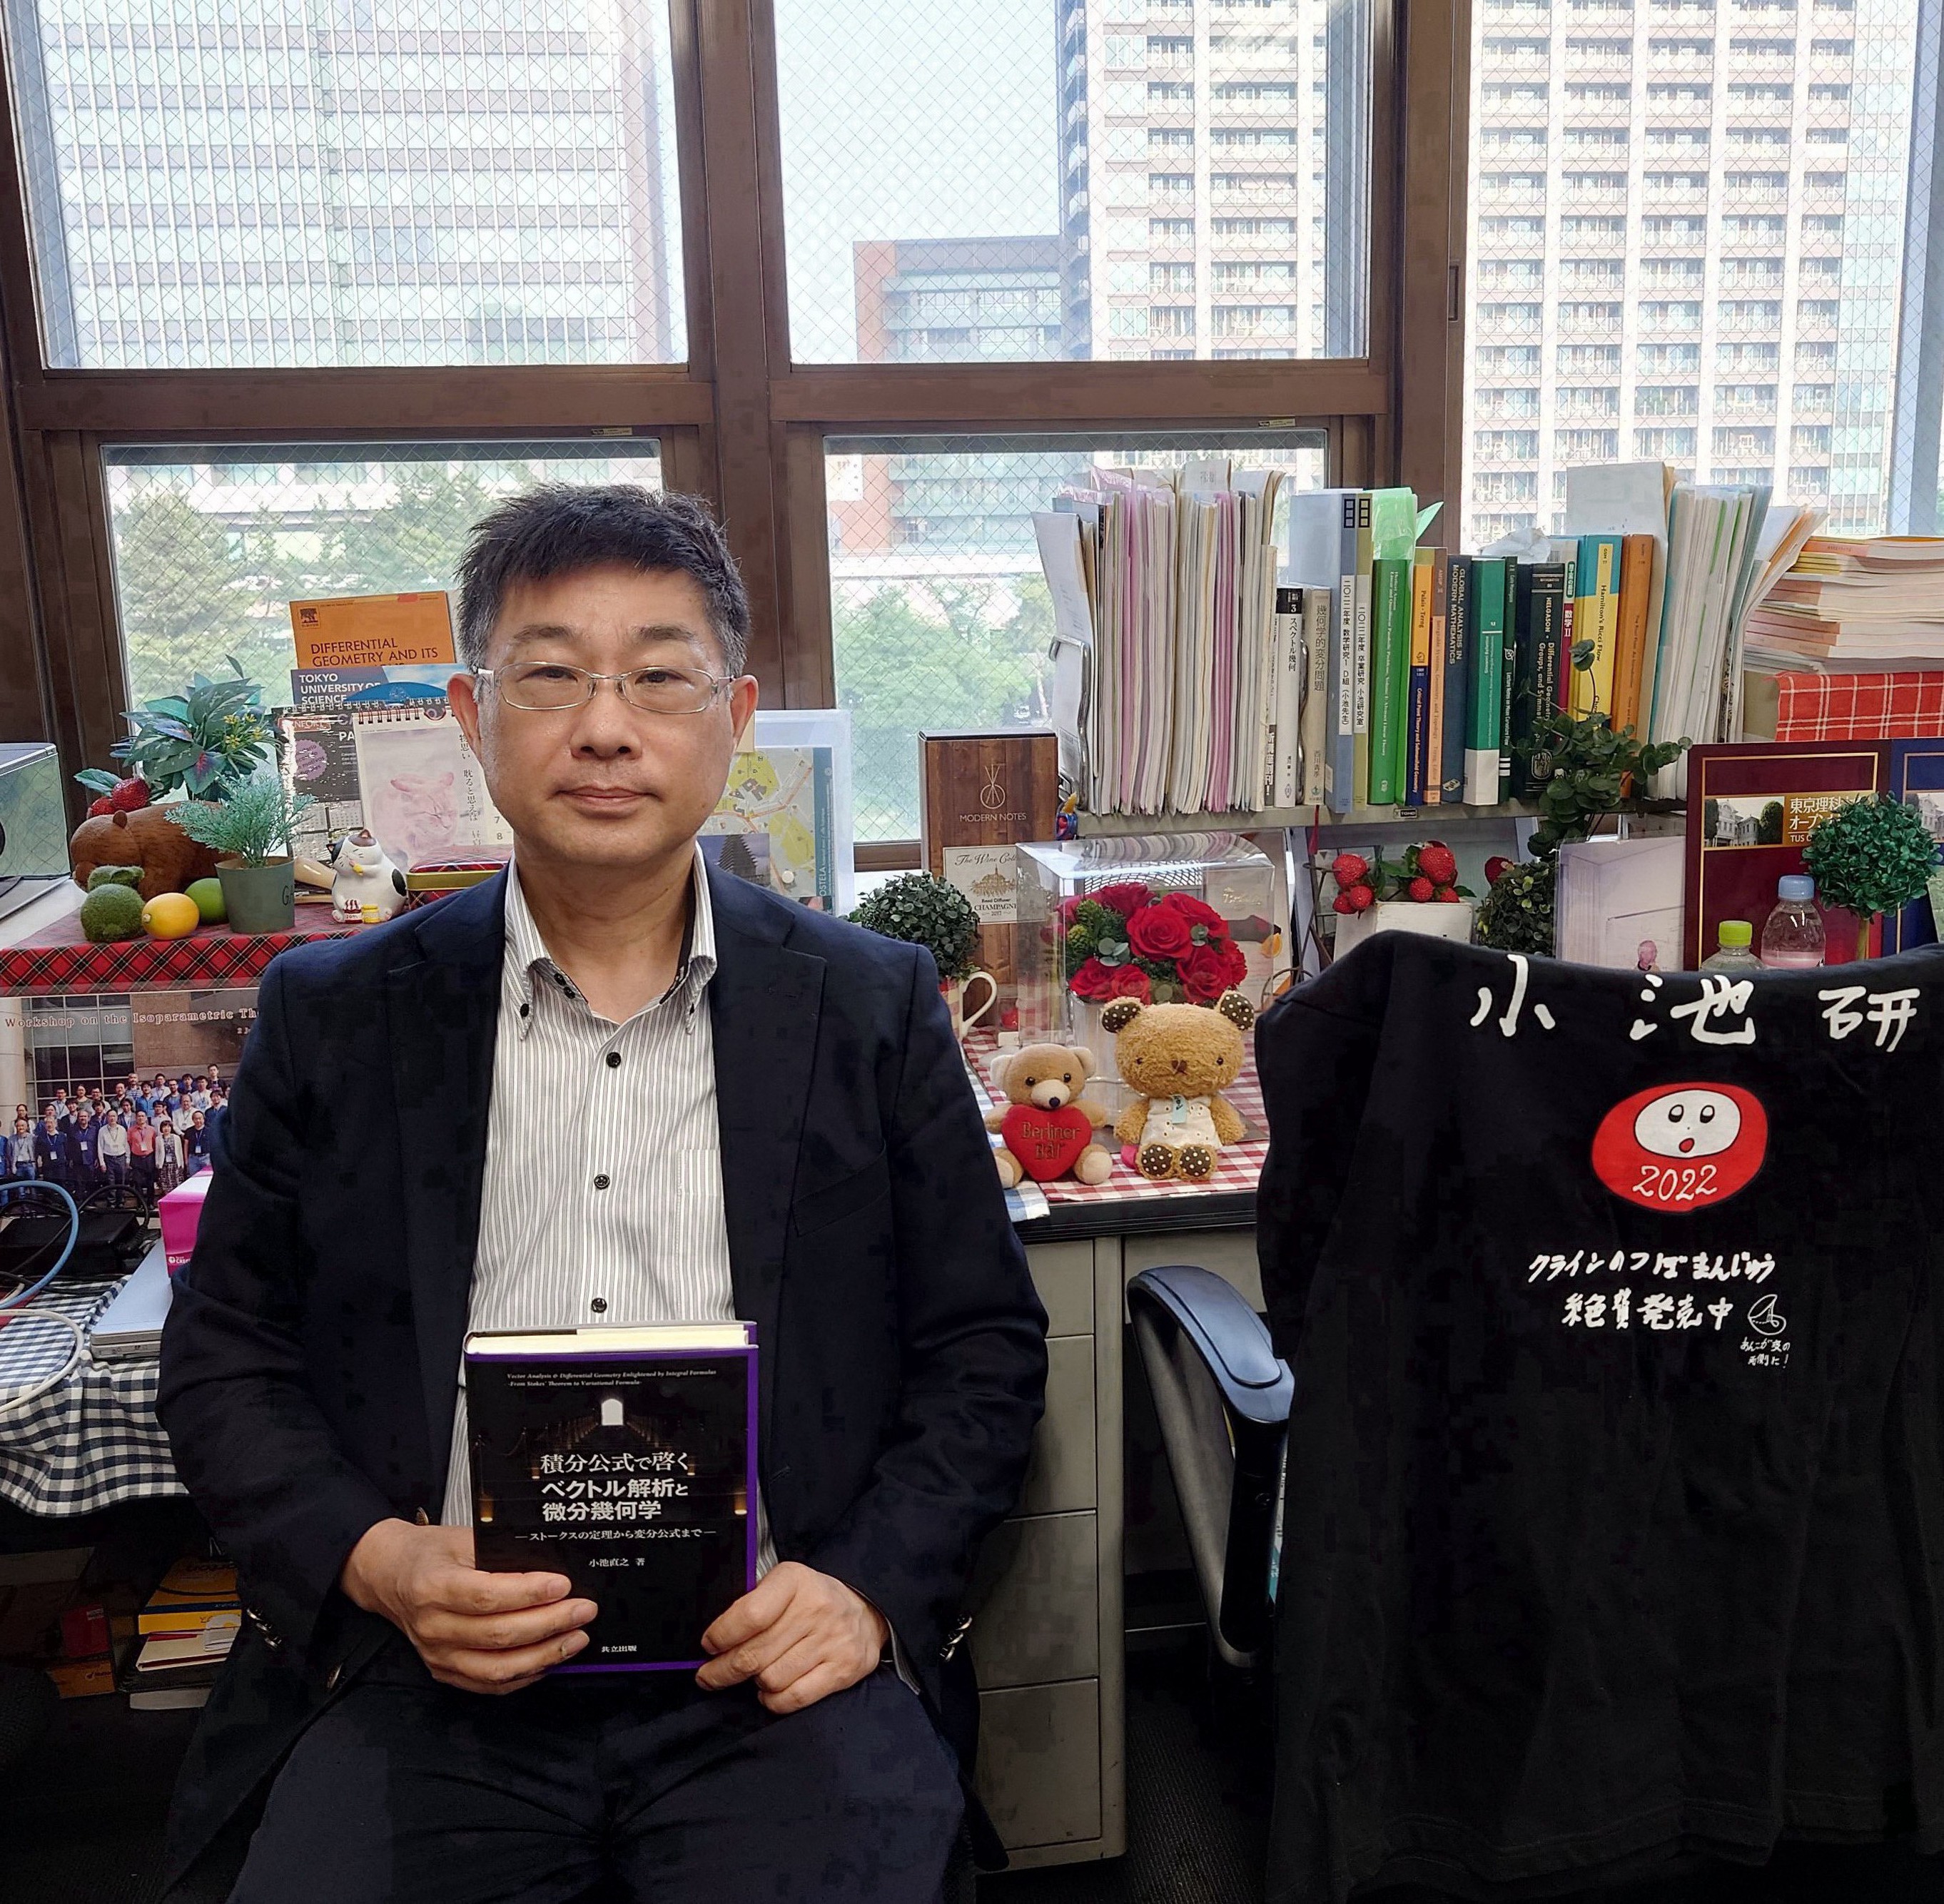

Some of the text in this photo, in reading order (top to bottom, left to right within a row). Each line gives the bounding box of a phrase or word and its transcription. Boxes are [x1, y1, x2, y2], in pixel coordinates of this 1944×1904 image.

[1290, 604, 1297, 613] 3
[311, 638, 398, 654] DIFFERENTIAL
[1287, 617, 1297, 672] スペクトル幾何
[1314, 604, 1327, 692] 幾何学的変分問題
[1456, 650, 1462, 659] IN
[312, 647, 439, 668] GEOMETRY AND ITS
[1537, 642, 1546, 672] Groups,
[1546, 642, 1555, 684] Differential
[299, 673, 338, 683] TOKYO
[1357, 655, 1365, 685] 卒業研究
[300, 683, 365, 694] UNIVERSITY
[1356, 688, 1365, 726] 小池研究室
[494, 816, 500, 824] 7
[959, 812, 1027, 822] MODERN NOTES
[496, 832, 503, 841] 8
[1790, 834, 1806, 843] TUS
[955, 853, 973, 866] The
[973, 852, 998, 865] Wine
[5, 1016, 75, 1029] Workshop
[81, 1016, 98, 1026] on
[105, 1013, 127, 1024] the
[133, 1008, 234, 1026] Isoparametric
[1022, 1121, 1081, 1140] Berliner
[1632, 1165, 1718, 1202] 2022
[1561, 1287, 1734, 1331] 絶賛発売中
[540, 1451, 689, 1474] 積分公式で啓く
[541, 1478, 689, 1499] ベクトル解析と
[542, 1500, 662, 1522] 微分幾何学
[589, 1557, 645, 1567] 小池直之 著
[601, 1644, 637, 1653] 共立出版
